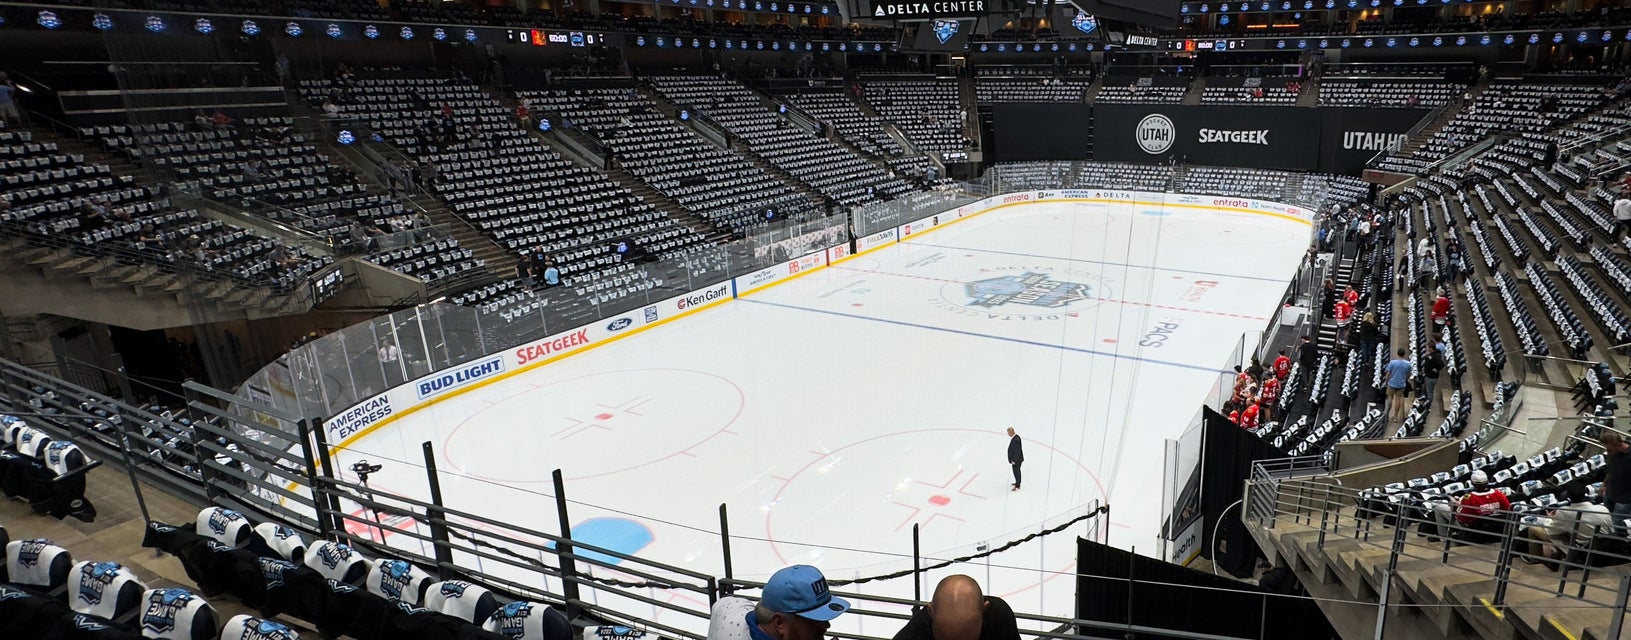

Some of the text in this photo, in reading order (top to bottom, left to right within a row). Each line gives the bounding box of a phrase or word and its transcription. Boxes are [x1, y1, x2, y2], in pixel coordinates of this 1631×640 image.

[887, 0, 984, 15] DELTA CENTER
[520, 31, 527, 42] 0
[587, 35, 593, 44] 0
[1130, 35, 1158, 46] DELTA CENTER
[1176, 42, 1182, 50] 0
[1229, 41, 1235, 49] 0
[1142, 127, 1169, 141] UTAH
[1198, 128, 1269, 145] SEATGEEK
[1343, 131, 1386, 151] UTAH
[1003, 193, 1029, 203] entrata
[1213, 199, 1248, 208] entrata
[686, 284, 727, 308] Ken Garff
[610, 319, 629, 331] Ford
[516, 327, 590, 366] SEATGEEK
[418, 359, 501, 396] BUD LIGHT
[329, 394, 390, 433] AMERICAN
[339, 405, 393, 439] EXPRESS
[81, 573, 105, 594] GAME
[383, 572, 403, 592] GAME
[148, 603, 177, 619] GAME
